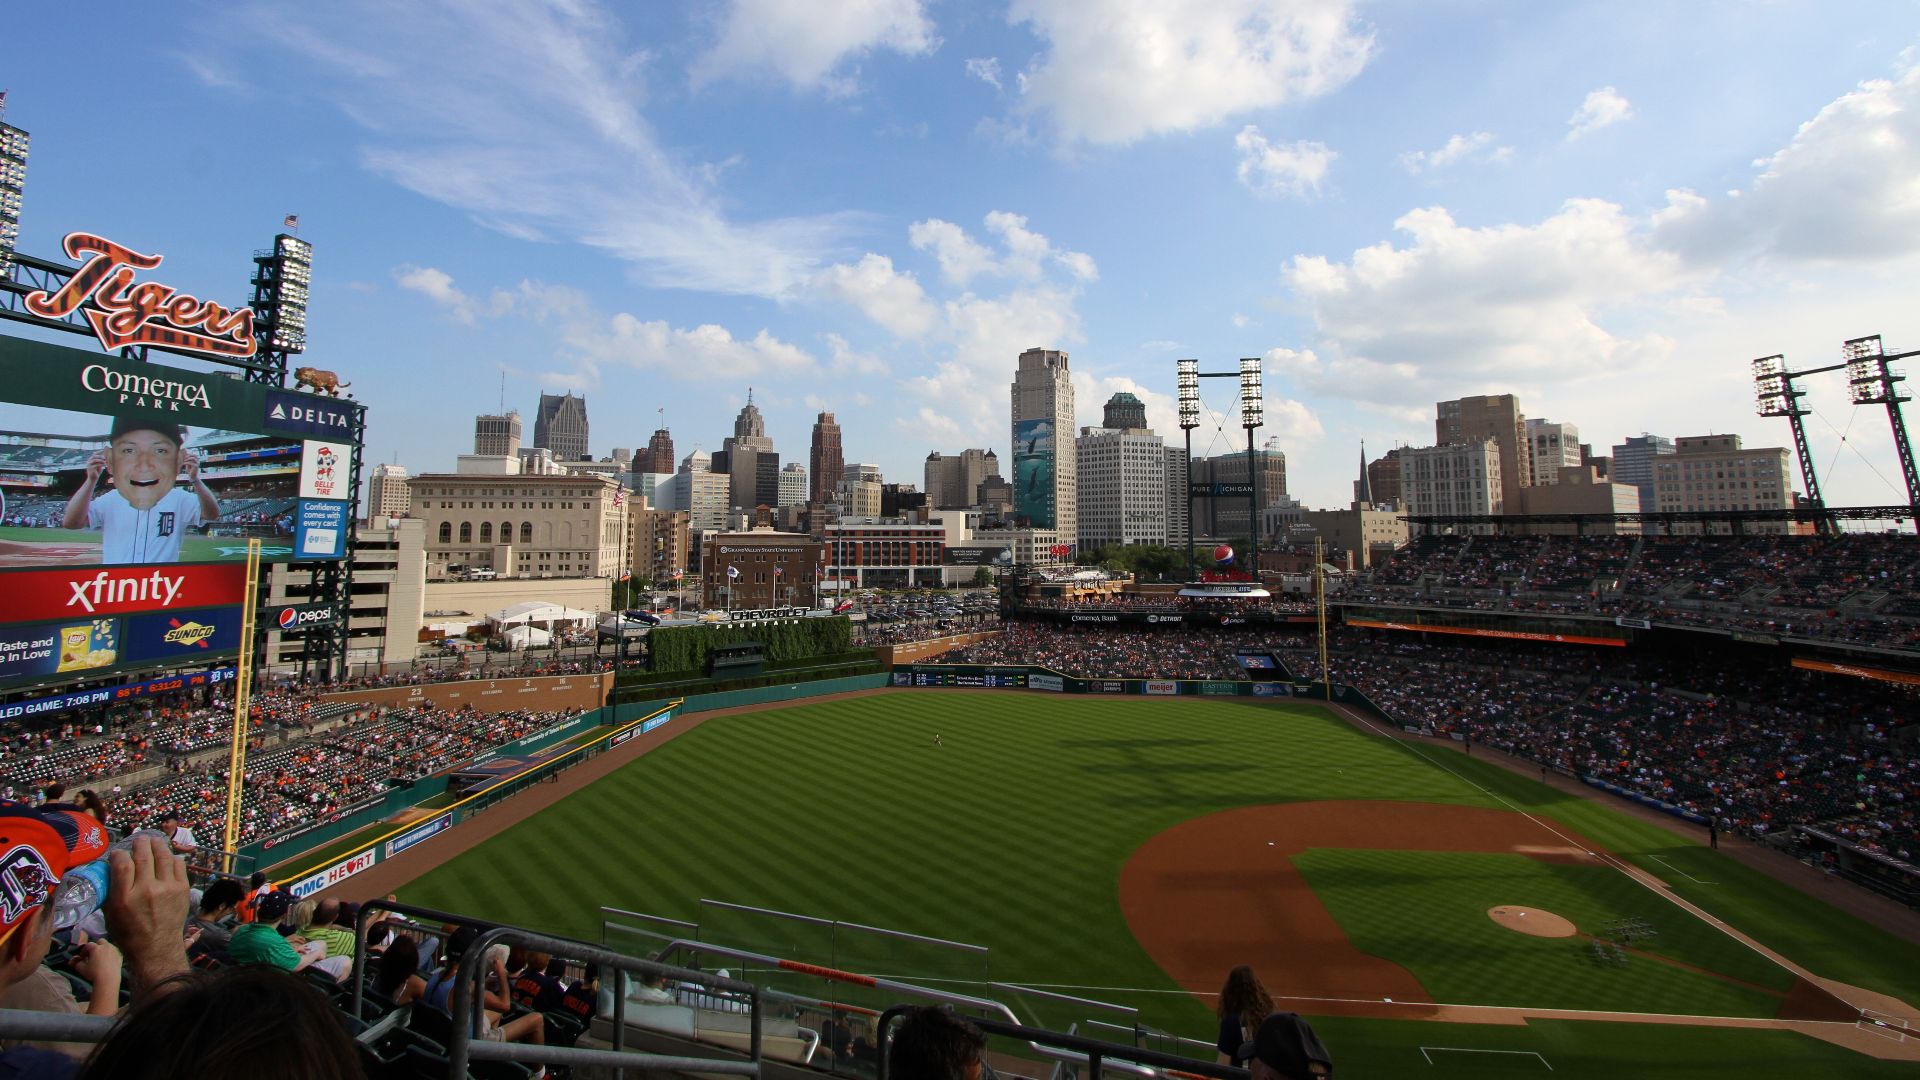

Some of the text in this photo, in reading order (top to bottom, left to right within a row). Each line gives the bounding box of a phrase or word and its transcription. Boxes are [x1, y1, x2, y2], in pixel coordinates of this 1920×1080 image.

[24, 231, 258, 357] Tigers
[119, 393, 180, 412] PARK
[291, 406, 348, 428] DELTA
[314, 480, 335, 489] BELLE
[316, 487, 331, 496] TIRE
[304, 502, 341, 512] Confidence
[303, 511, 341, 520] comes with
[303, 520, 321, 529] every
[66, 570, 185, 613] xfinity
[298, 606, 332, 625] pepsi
[730, 606, 811, 621] CHEVROLET
[716, 620, 799, 630] FOUNTAIN
[167, 626, 213, 641] SUNOCO
[0, 637, 54, 652] Taste and
[8, 653, 20, 662] In
[23, 649, 51, 660] Love
[190, 676, 205, 685] PM
[224, 671, 234, 680] VS
[148, 680, 183, 693] 6:31:22
[411, 687, 422, 696] 23
[1149, 682, 1173, 693] meijer
[26, 700, 64, 714] GAME:
[66, 695, 90, 707] 7:08
[92, 692, 109, 703] PM
[340, 808, 353, 819] ATI
[275, 834, 290, 844] ATI
[293, 875, 325, 896] DMC
